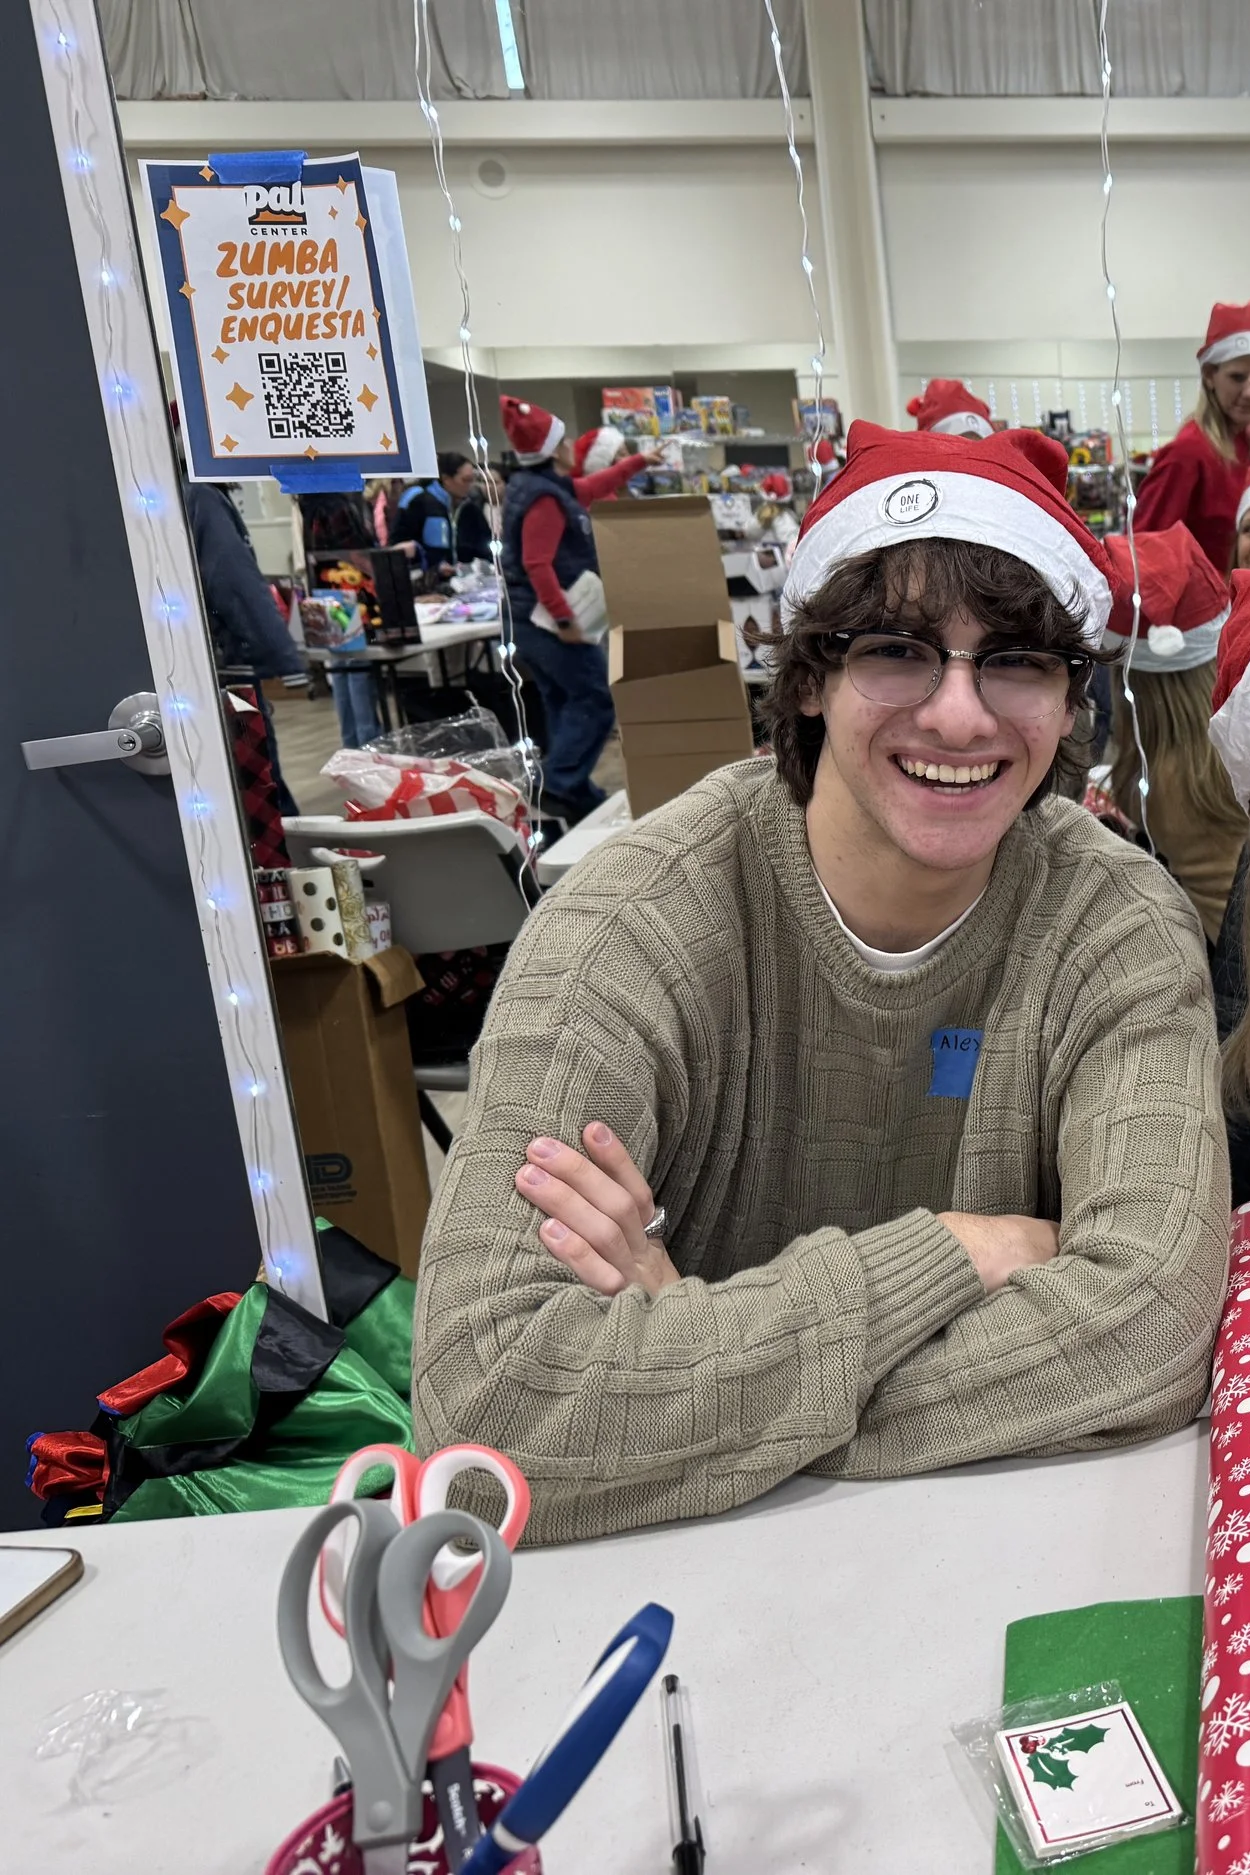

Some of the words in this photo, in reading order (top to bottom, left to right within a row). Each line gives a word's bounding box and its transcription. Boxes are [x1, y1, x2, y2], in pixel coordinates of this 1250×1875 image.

[250, 227, 308, 236] CENTER
[216, 238, 338, 278] ZUMBA
[227, 275, 350, 311] SURVEY/
[220, 309, 365, 344] ENQUESTA
[900, 493, 920, 507] ONE
[900, 504, 920, 514] LIFE
